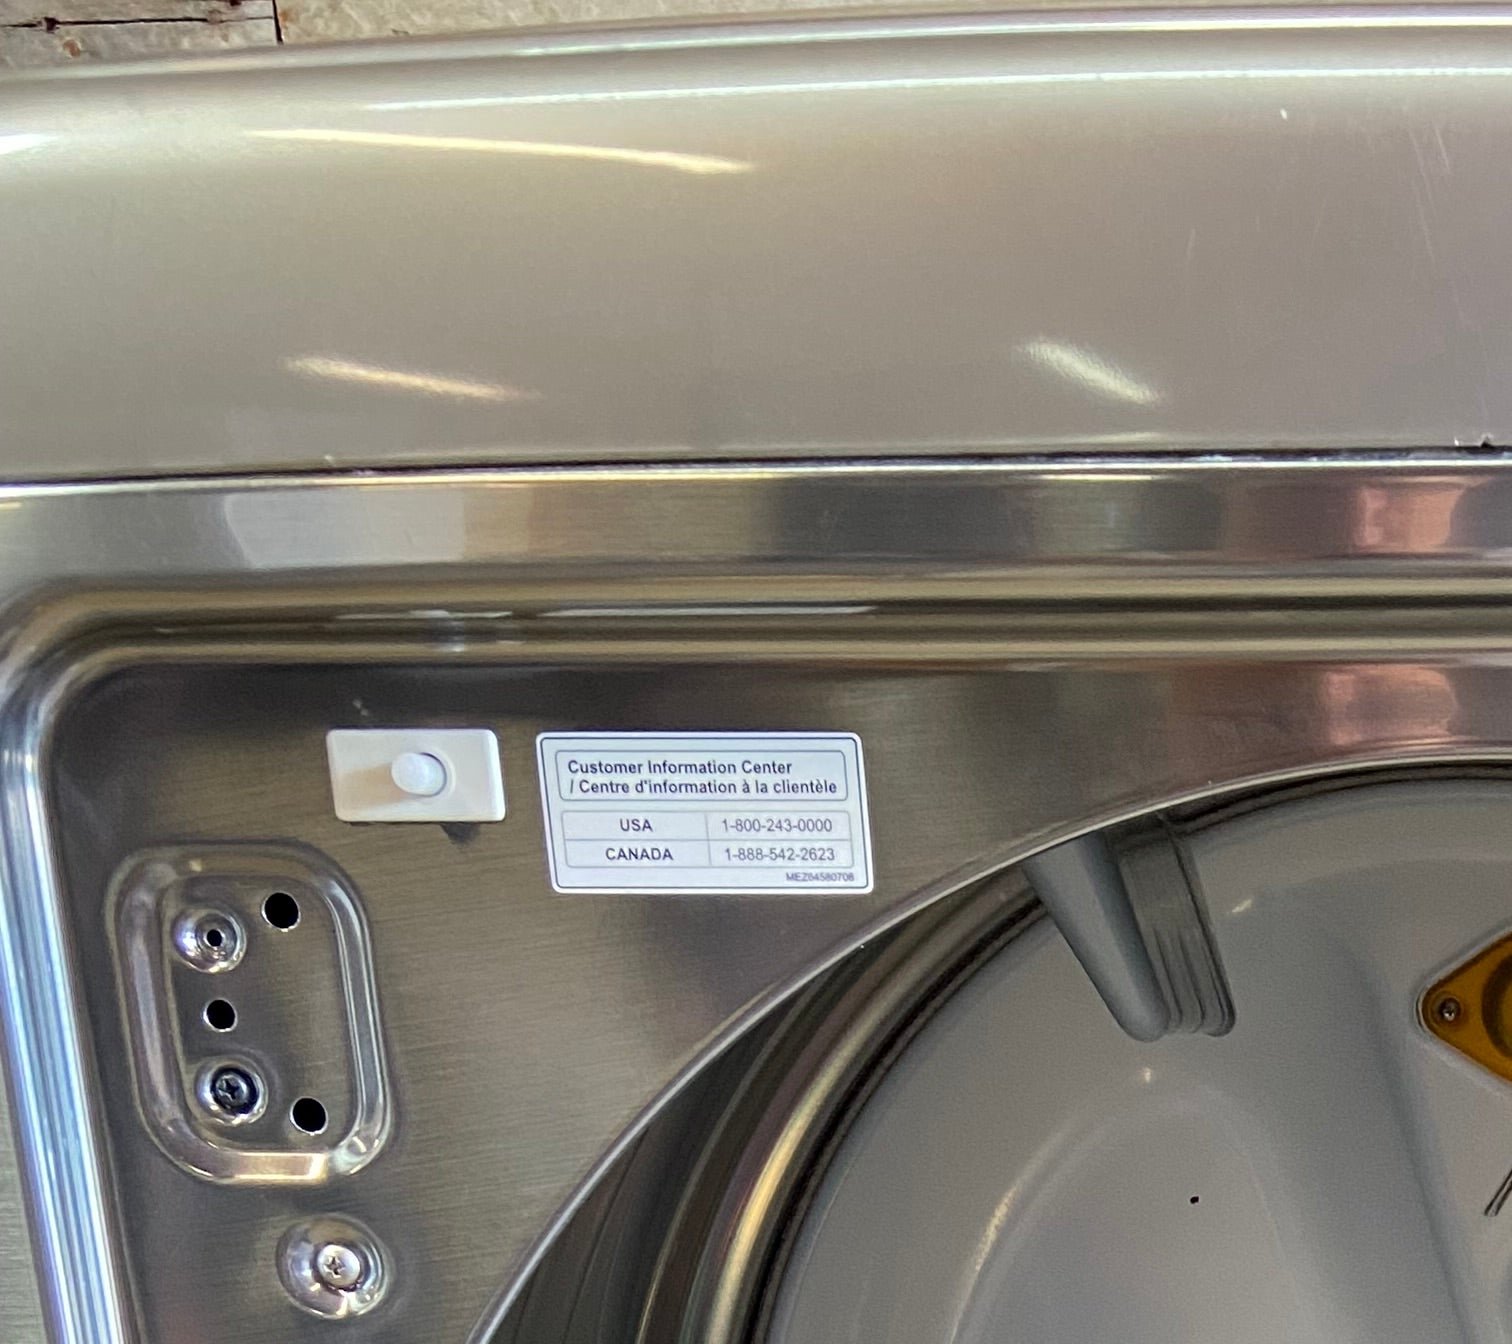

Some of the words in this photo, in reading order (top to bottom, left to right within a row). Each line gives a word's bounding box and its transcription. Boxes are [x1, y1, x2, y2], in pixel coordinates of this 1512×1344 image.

[568, 760, 643, 774] Customer
[648, 760, 736, 774] Information
[742, 760, 792, 774] Center
[579, 780, 629, 793] Centre
[636, 780, 736, 793] d'information
[742, 780, 750, 793] à
[755, 780, 768, 793] la
[773, 780, 837, 793] clientèle
[620, 819, 653, 832] USA
[722, 819, 832, 832] 1-800-243-0000
[606, 848, 673, 860] CANADA
[725, 848, 835, 861] 1-888-542-2623
